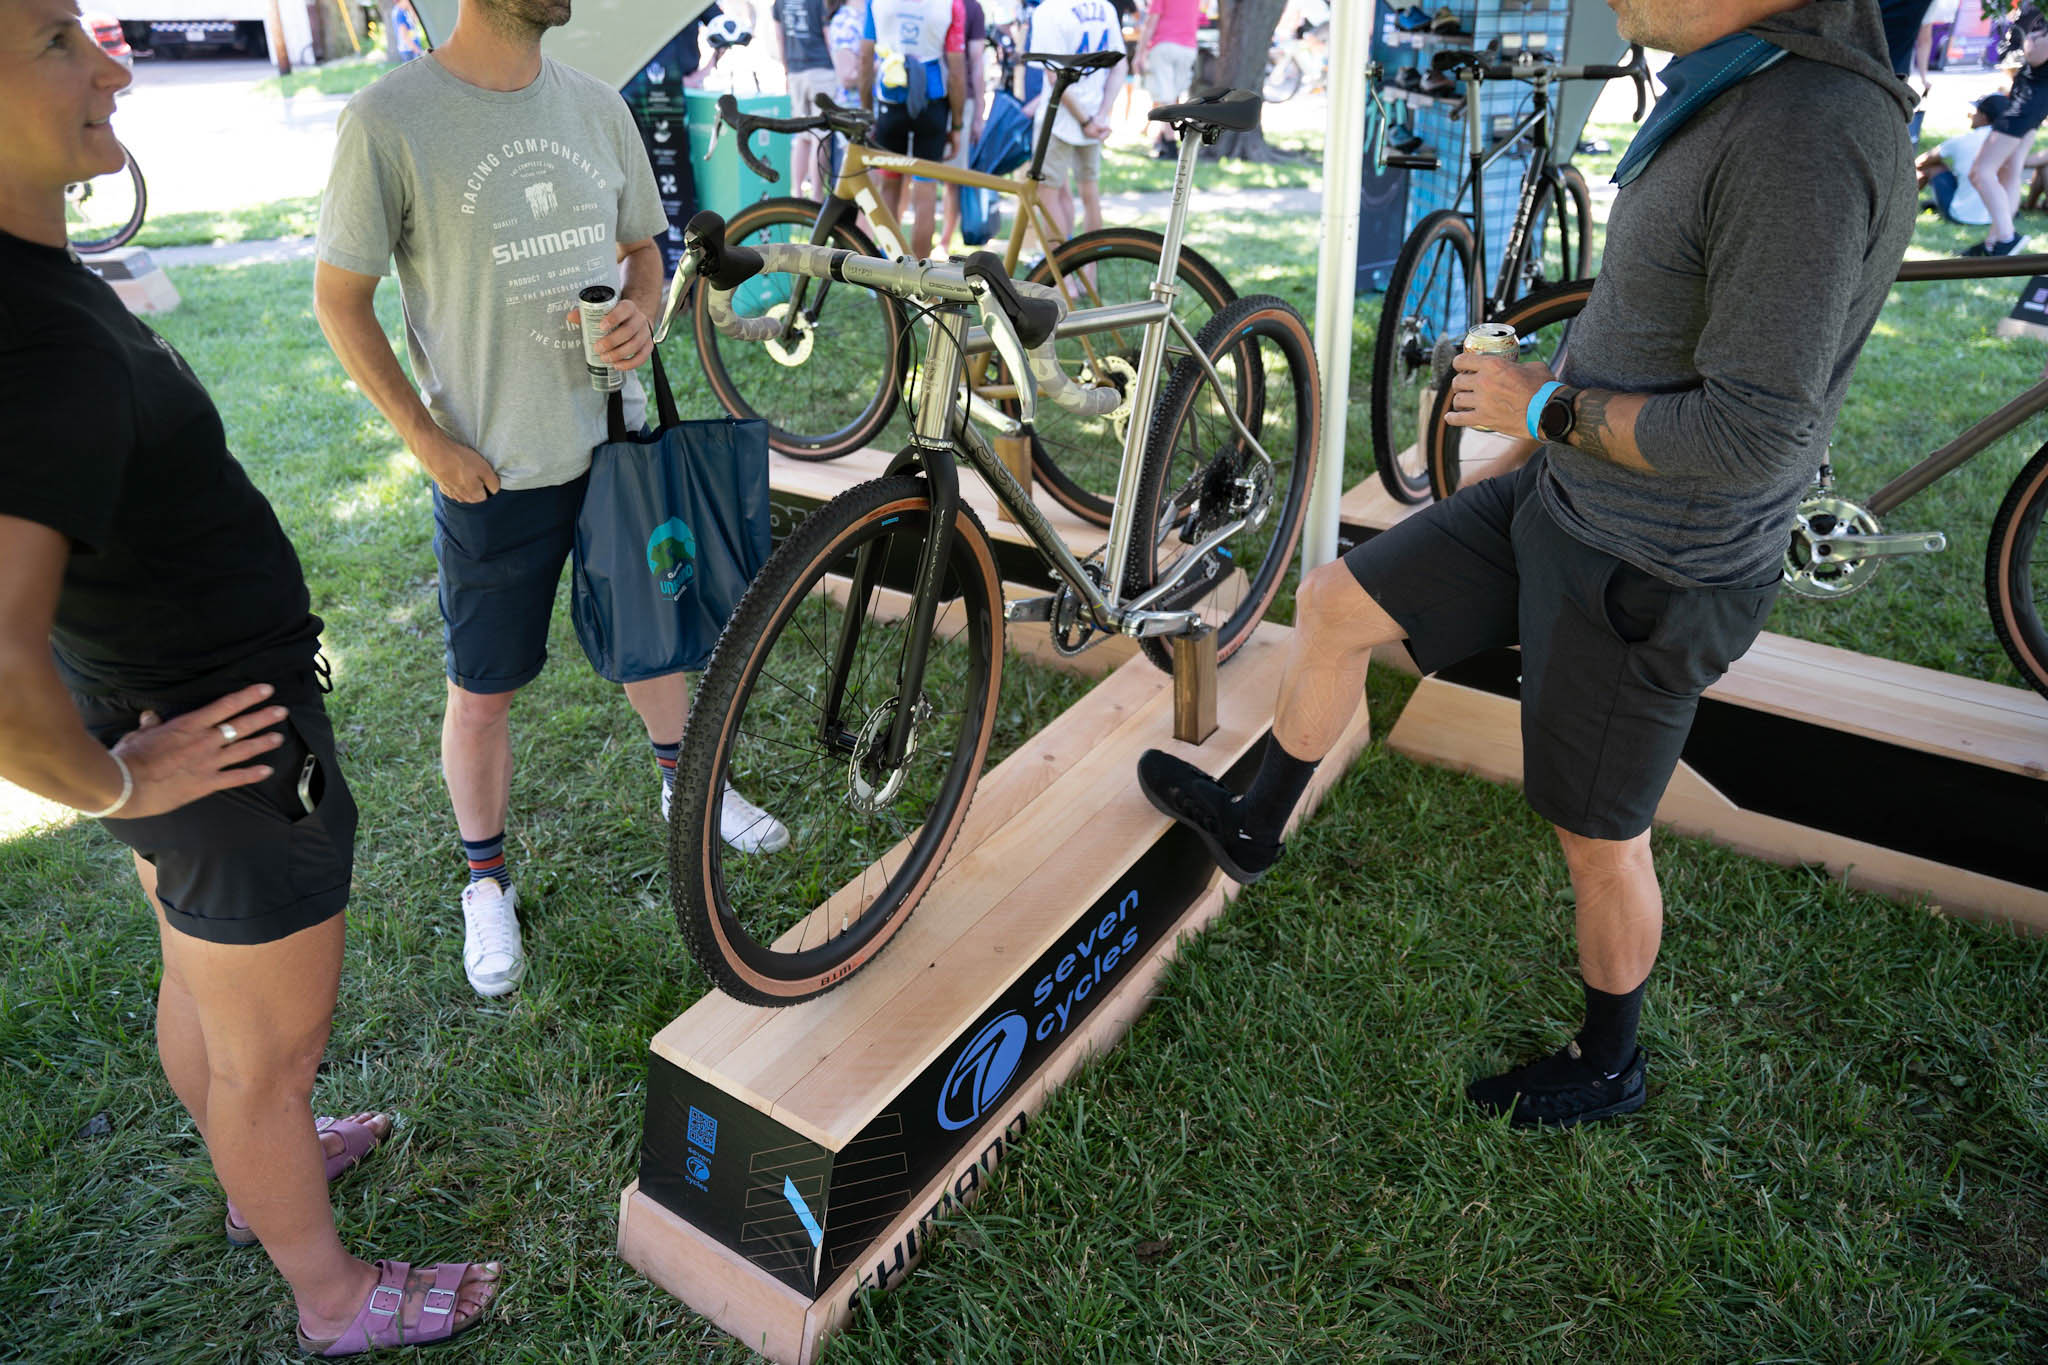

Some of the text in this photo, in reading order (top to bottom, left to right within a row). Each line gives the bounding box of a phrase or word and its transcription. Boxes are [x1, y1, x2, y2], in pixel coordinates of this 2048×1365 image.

[461, 138, 606, 215] RACING COMPONENTS
[493, 218, 519, 230] QUALITY
[492, 223, 606, 265] SHIMANO
[508, 265, 580, 289] PRODUCT OF JAPAN
[522, 291, 537, 301] THE
[529, 328, 582, 350] THE COMP
[1033, 889, 1139, 1008] seven
[1035, 925, 1139, 1041] cycles
[687, 1146, 713, 1166] seven
[683, 1175, 710, 1193] cycles
